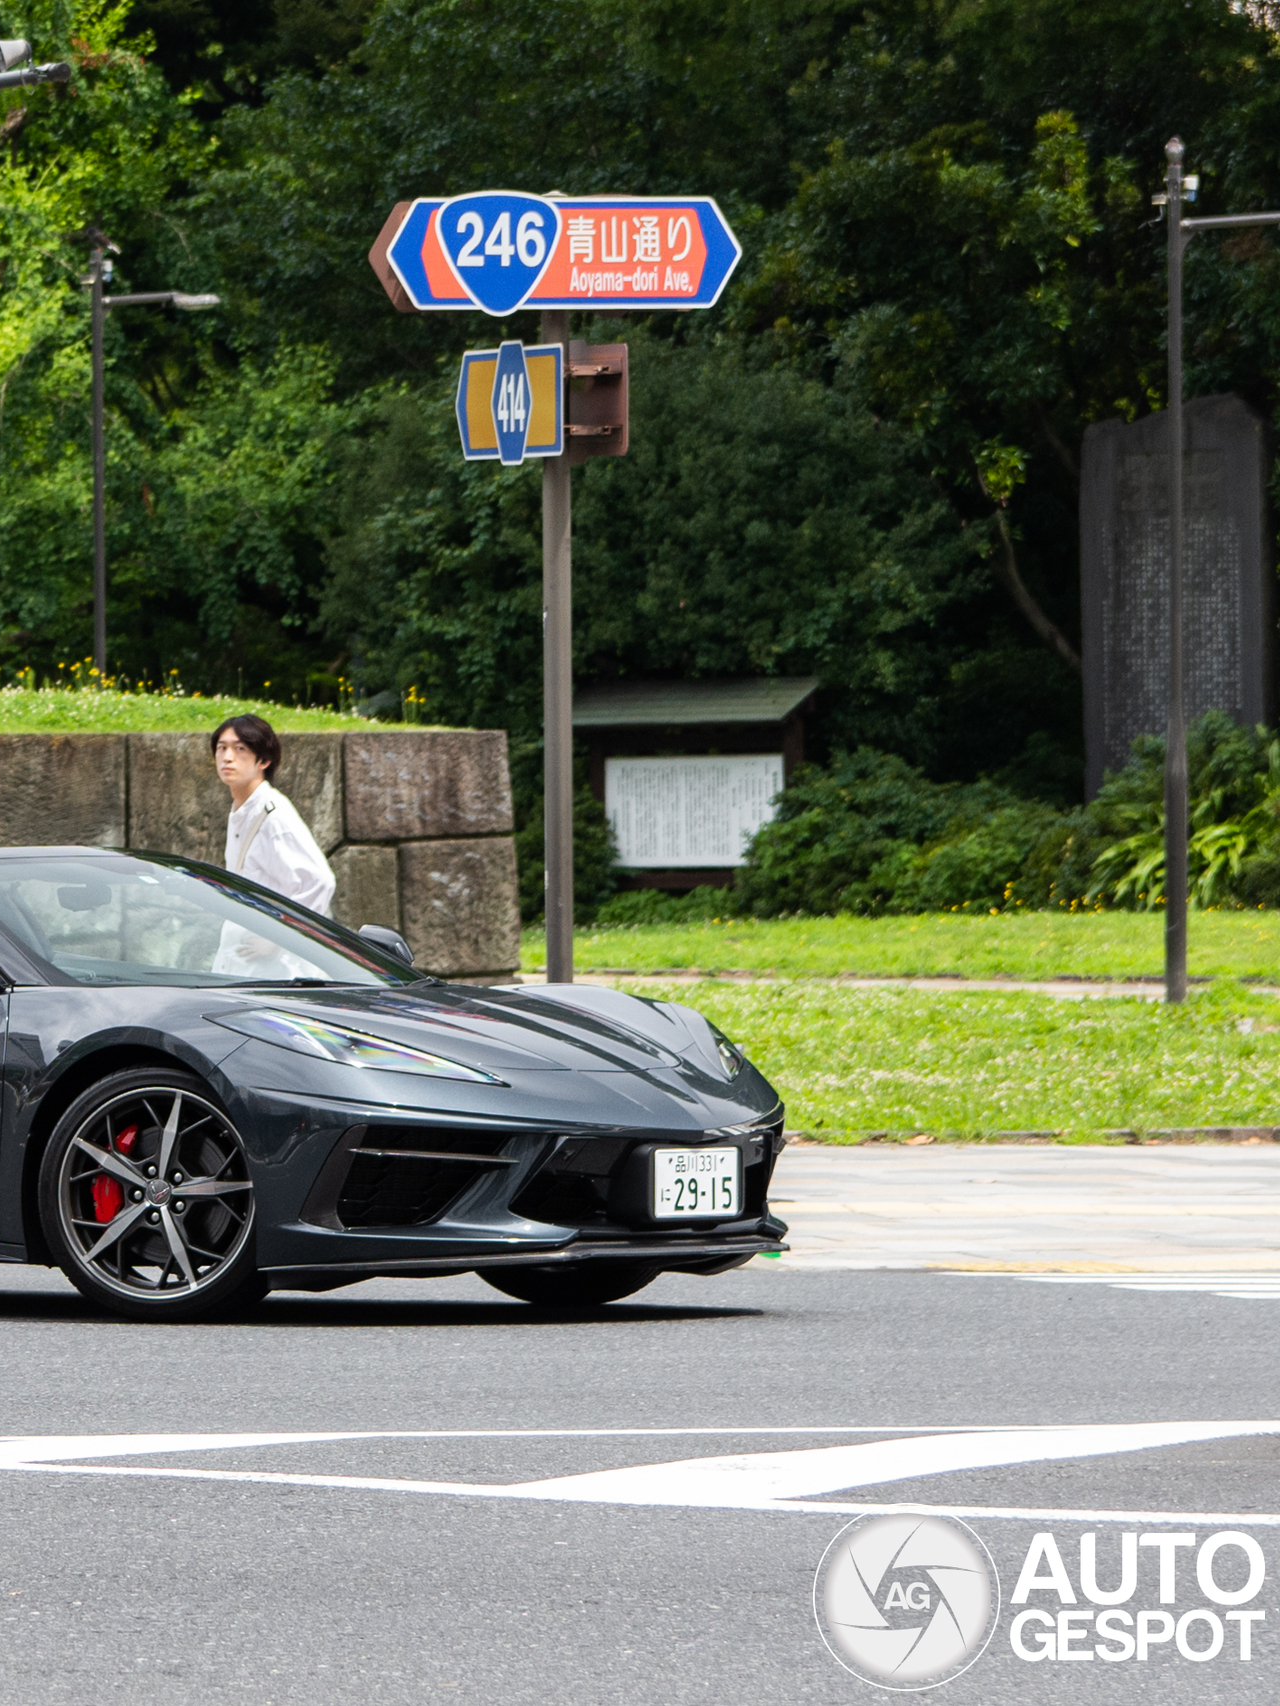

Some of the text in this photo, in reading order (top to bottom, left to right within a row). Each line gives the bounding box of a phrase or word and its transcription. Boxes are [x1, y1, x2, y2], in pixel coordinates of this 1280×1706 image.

[456, 211, 545, 268] 246
[567, 215, 692, 264] 青山通り
[569, 266, 693, 297] Aoyama-dori Ave.
[498, 373, 525, 433] 414
[674, 1176, 732, 1211] 29-15
